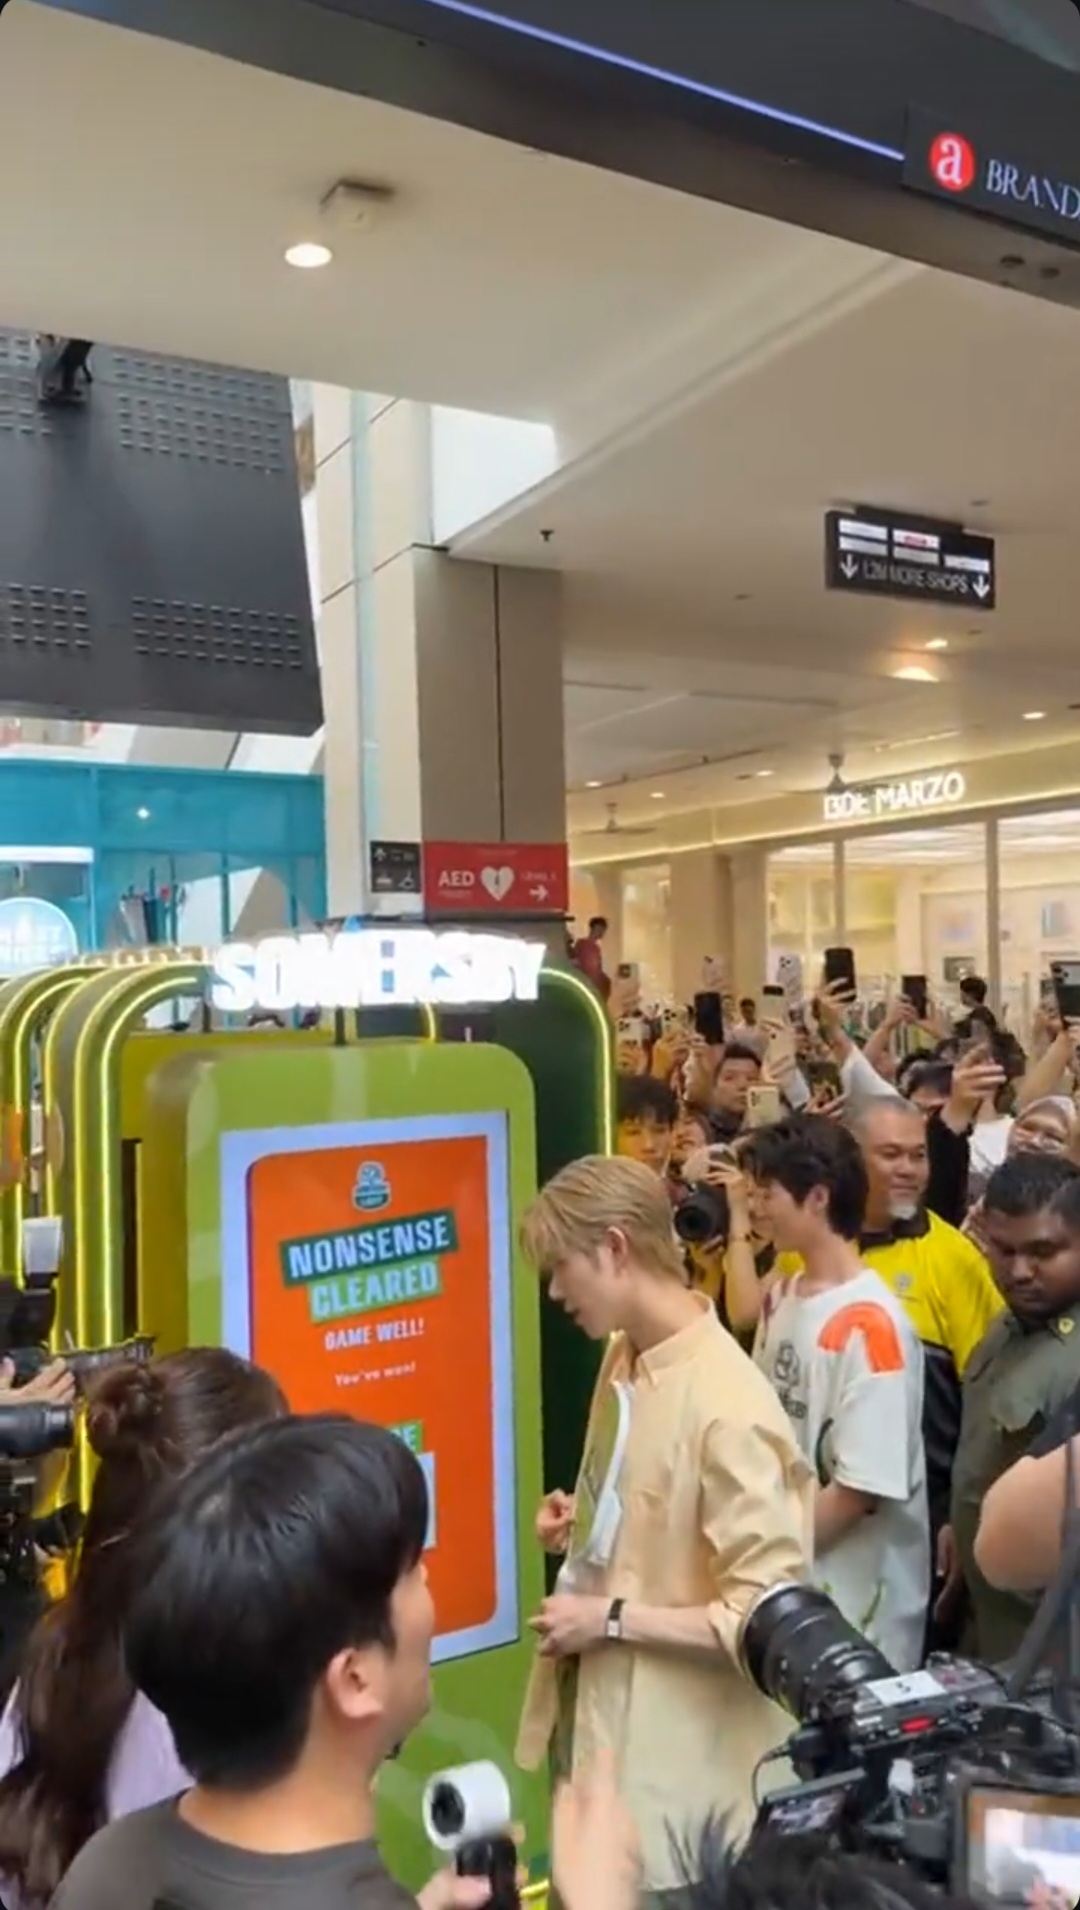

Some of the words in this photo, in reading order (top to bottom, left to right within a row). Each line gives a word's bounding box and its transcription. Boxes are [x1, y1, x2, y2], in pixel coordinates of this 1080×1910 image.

[874, 771, 966, 815] MARZO
[438, 869, 475, 887] AED
[288, 1216, 449, 1279] NONSENSE
[311, 1261, 437, 1318] CLEARED
[324, 1325, 371, 1351] GAME
[376, 1317, 424, 1343] WELL!
